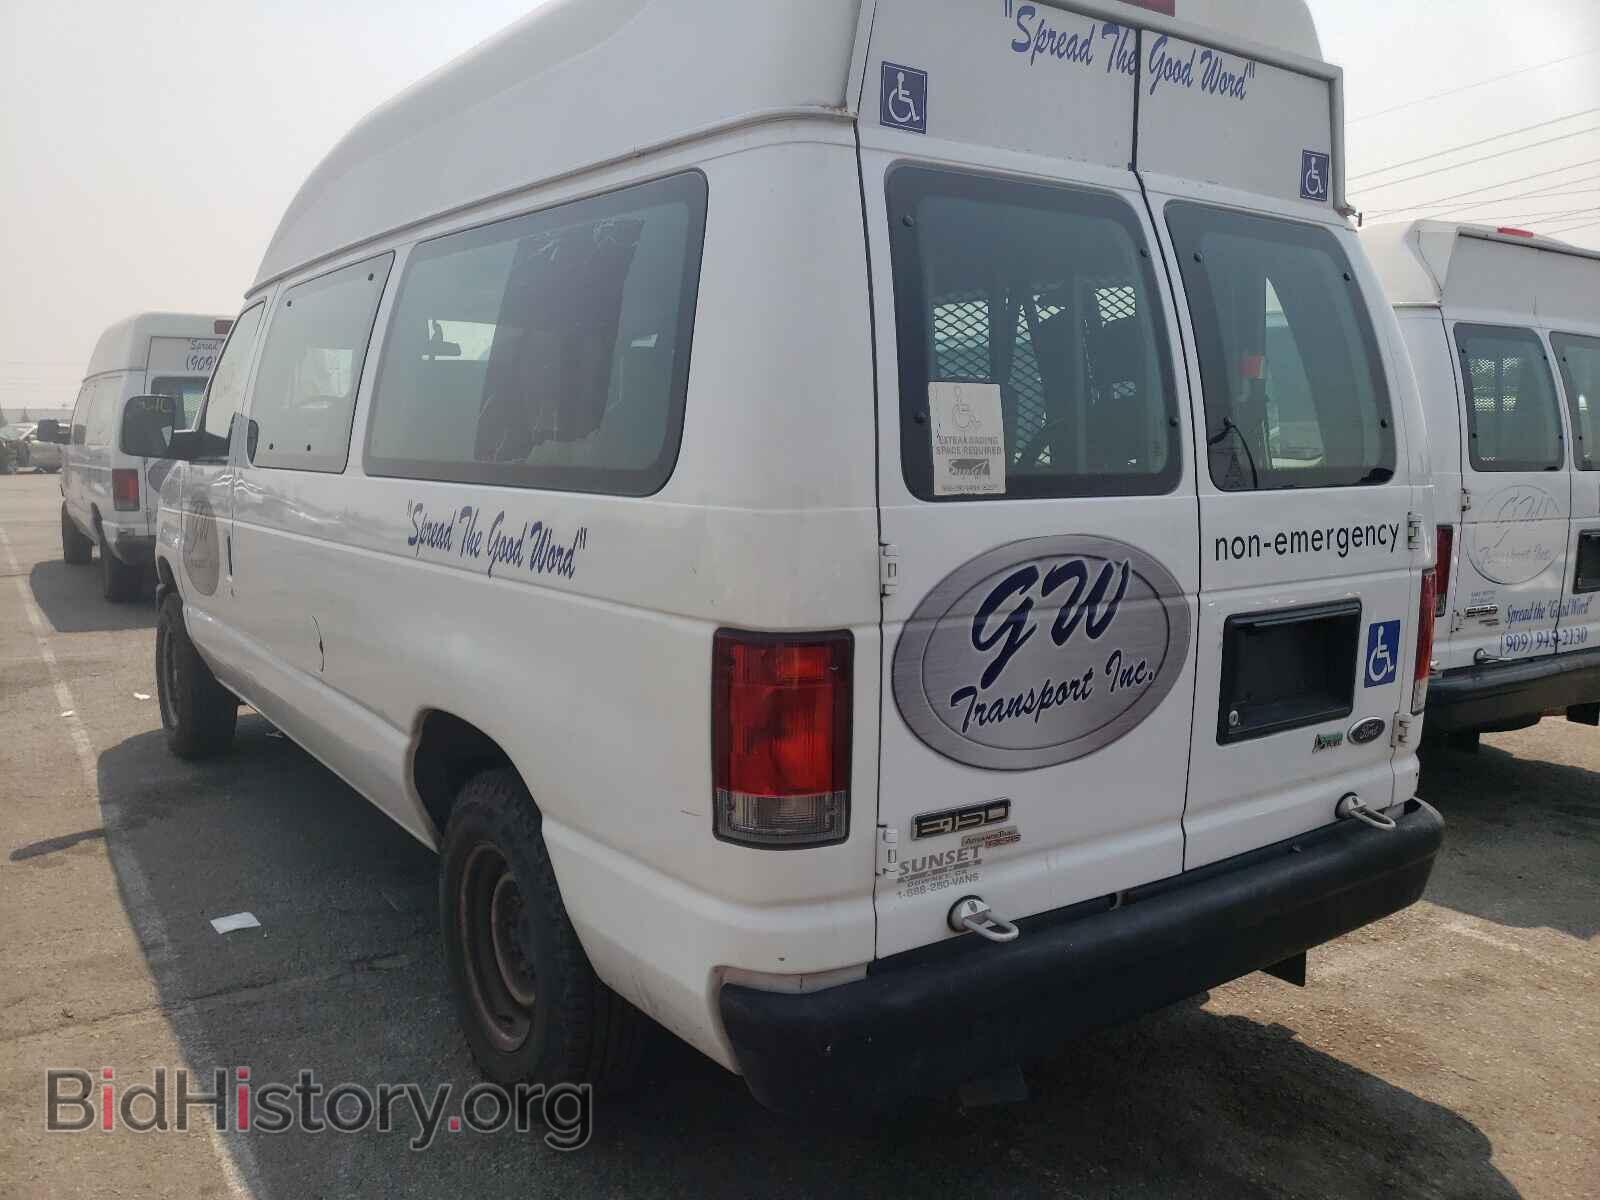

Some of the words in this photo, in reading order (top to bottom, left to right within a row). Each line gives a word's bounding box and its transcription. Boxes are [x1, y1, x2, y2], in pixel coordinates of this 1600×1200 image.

[1003, 0, 1095, 66] "Spread
[1101, 23, 1139, 74] The
[1149, 33, 1195, 96] Good
[1200, 50, 1255, 100] Word"
[458, 505, 483, 559] The
[487, 510, 528, 578] Good
[1215, 522, 1400, 561] non-emergency
[970, 558, 1131, 690] GW
[950, 667, 1094, 733] Transport
[1105, 650, 1154, 692] Inc.
[898, 846, 981, 875] SUNSET
